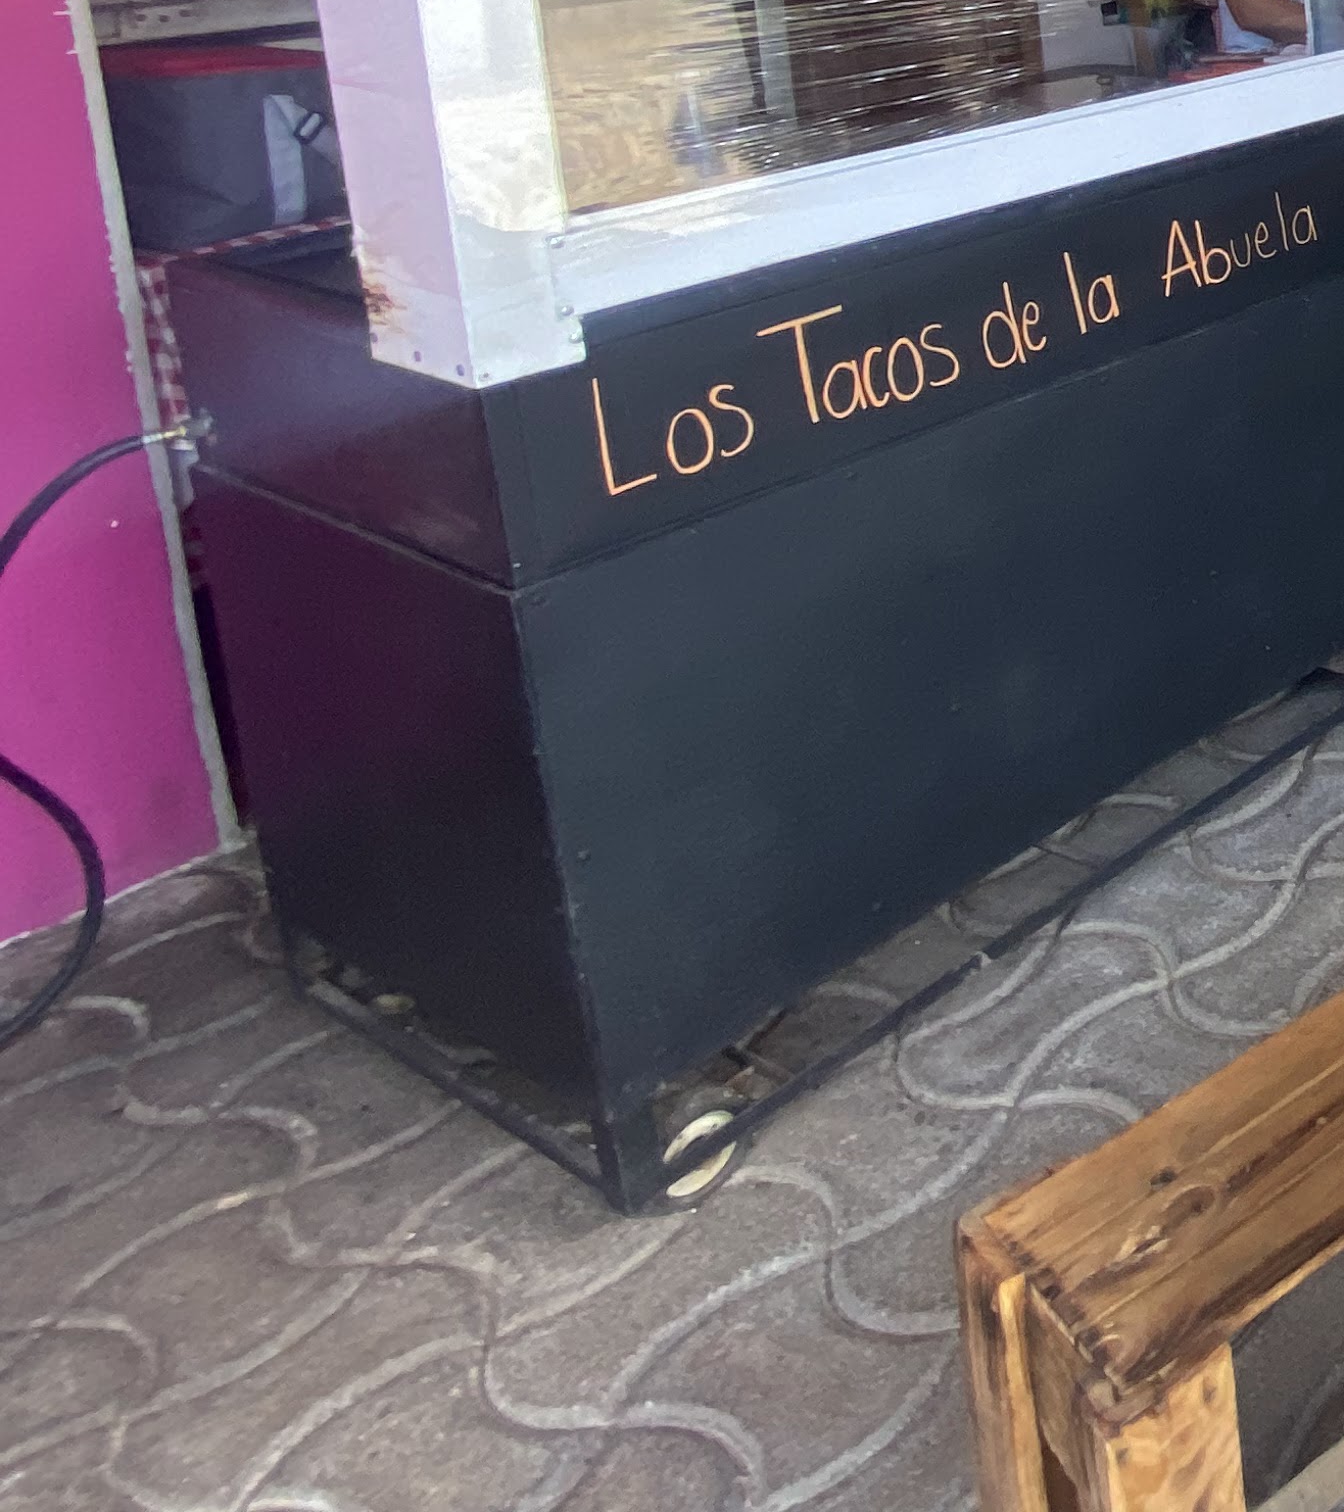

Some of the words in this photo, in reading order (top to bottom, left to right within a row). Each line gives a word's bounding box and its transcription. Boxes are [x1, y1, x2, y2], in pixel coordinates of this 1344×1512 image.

[592, 376, 755, 497] Los
[757, 304, 961, 425] Tacos
[982, 281, 1047, 370] de
[1062, 252, 1121, 335] la
[1162, 191, 1319, 298] Abuela
